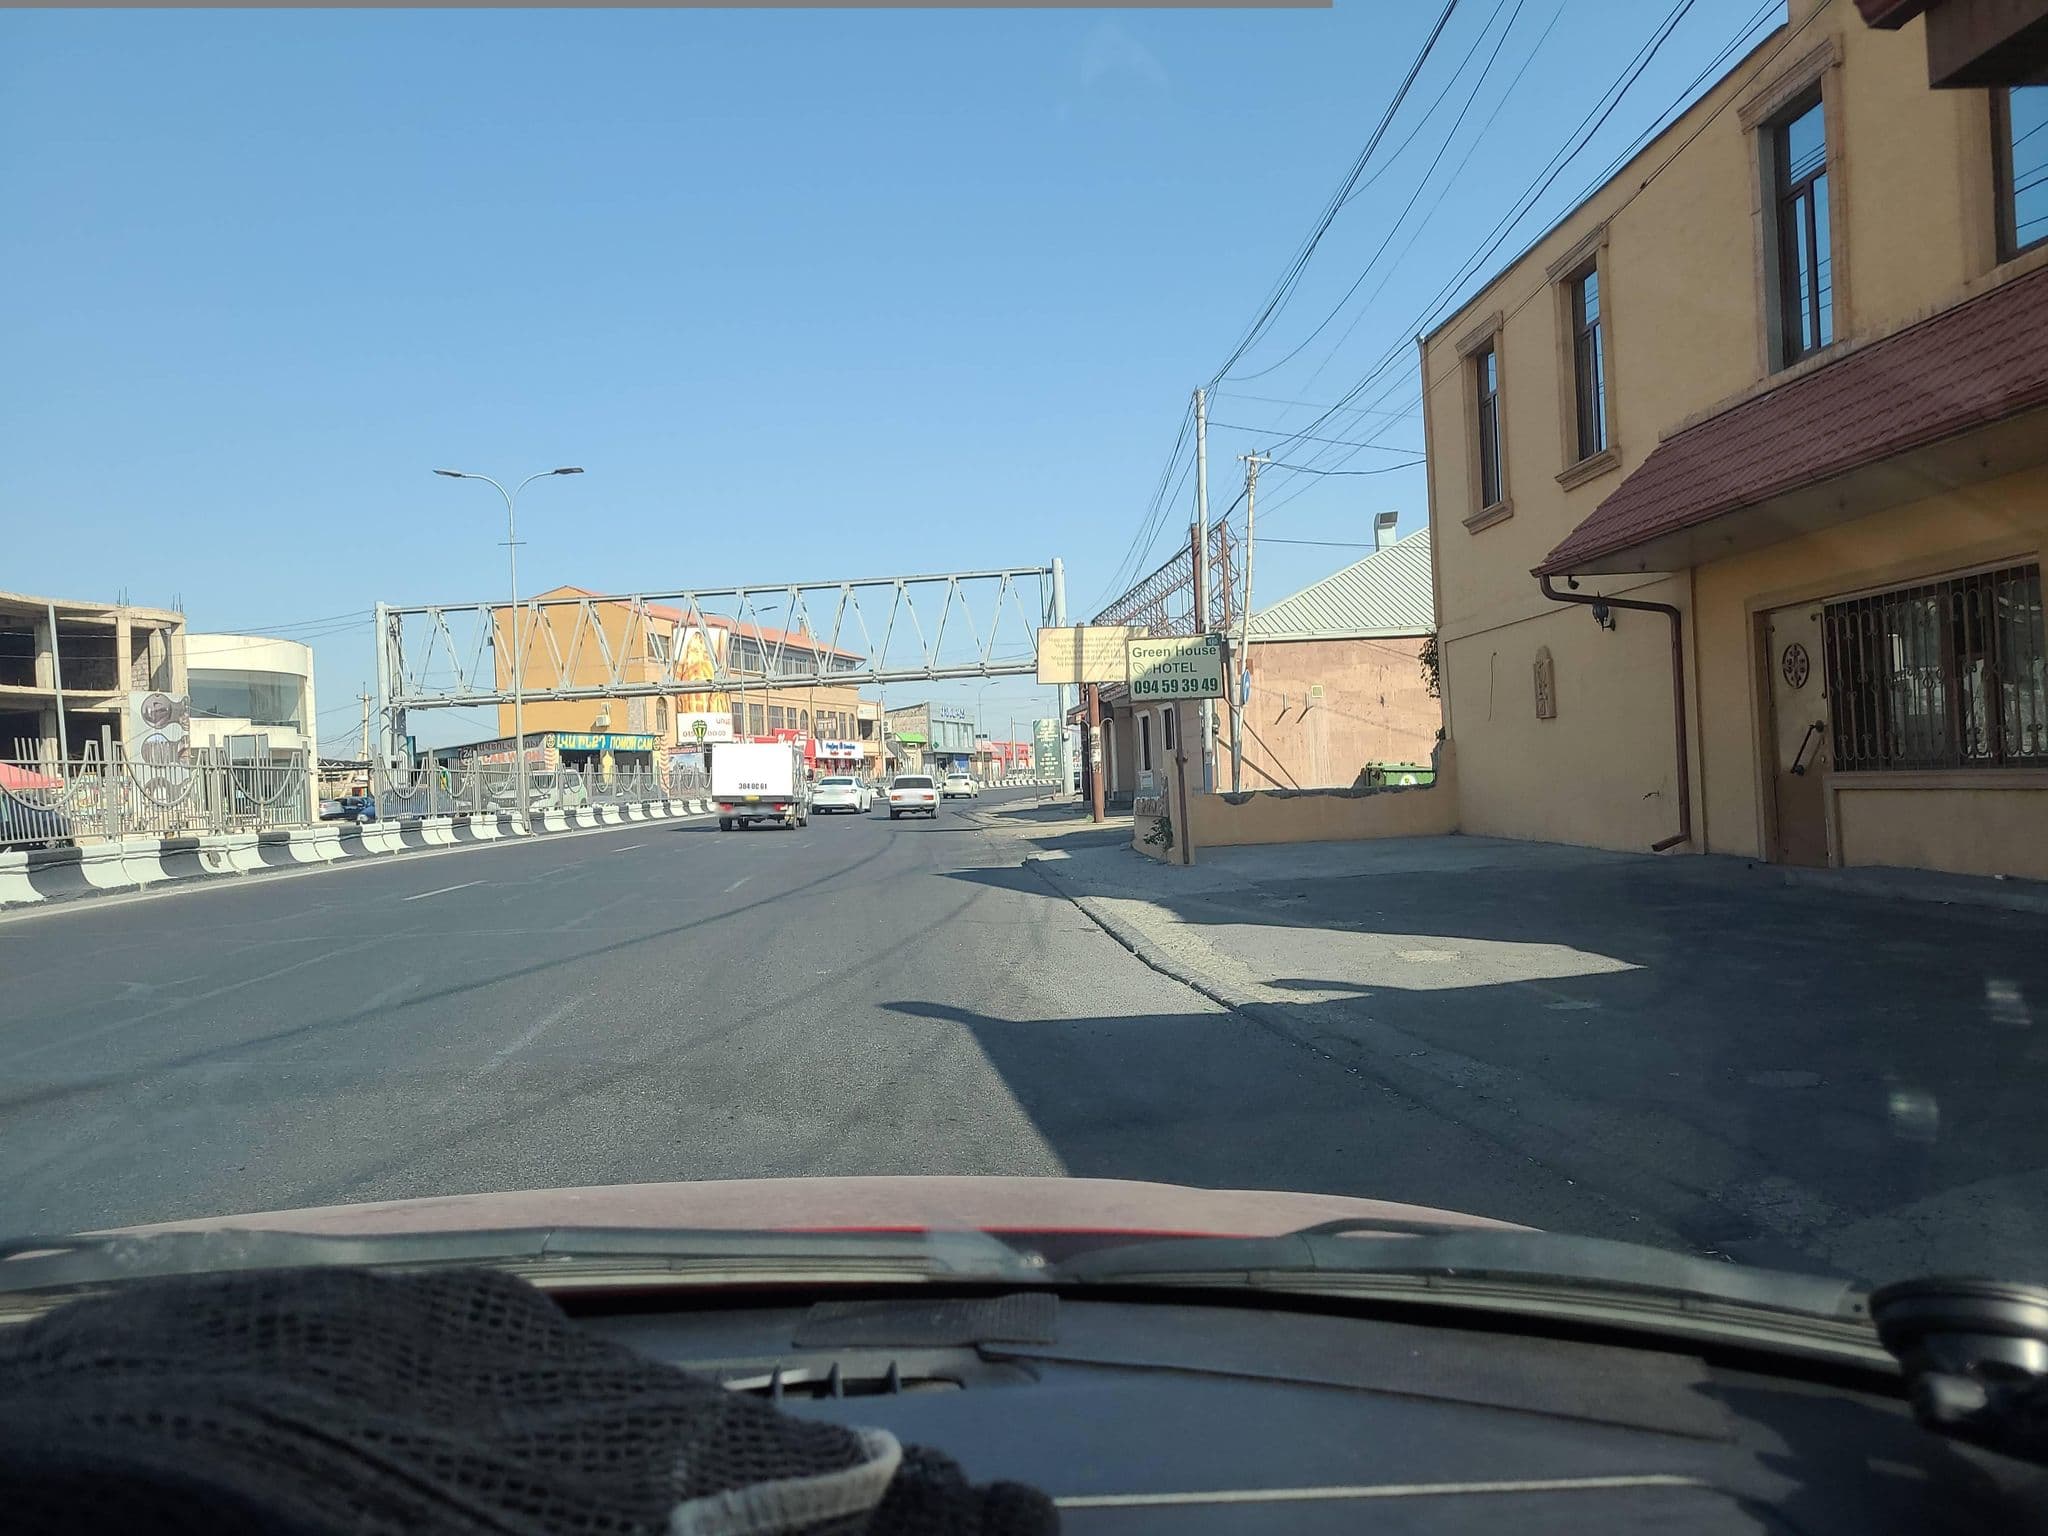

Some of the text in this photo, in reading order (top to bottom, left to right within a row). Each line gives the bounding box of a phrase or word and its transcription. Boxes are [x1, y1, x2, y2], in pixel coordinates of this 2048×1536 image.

[1132, 647, 1171, 658] Green
[1176, 645, 1217, 657] House
[1153, 662, 1197, 674] HOTEL
[1134, 677, 1218, 694] 094 59 39 49
